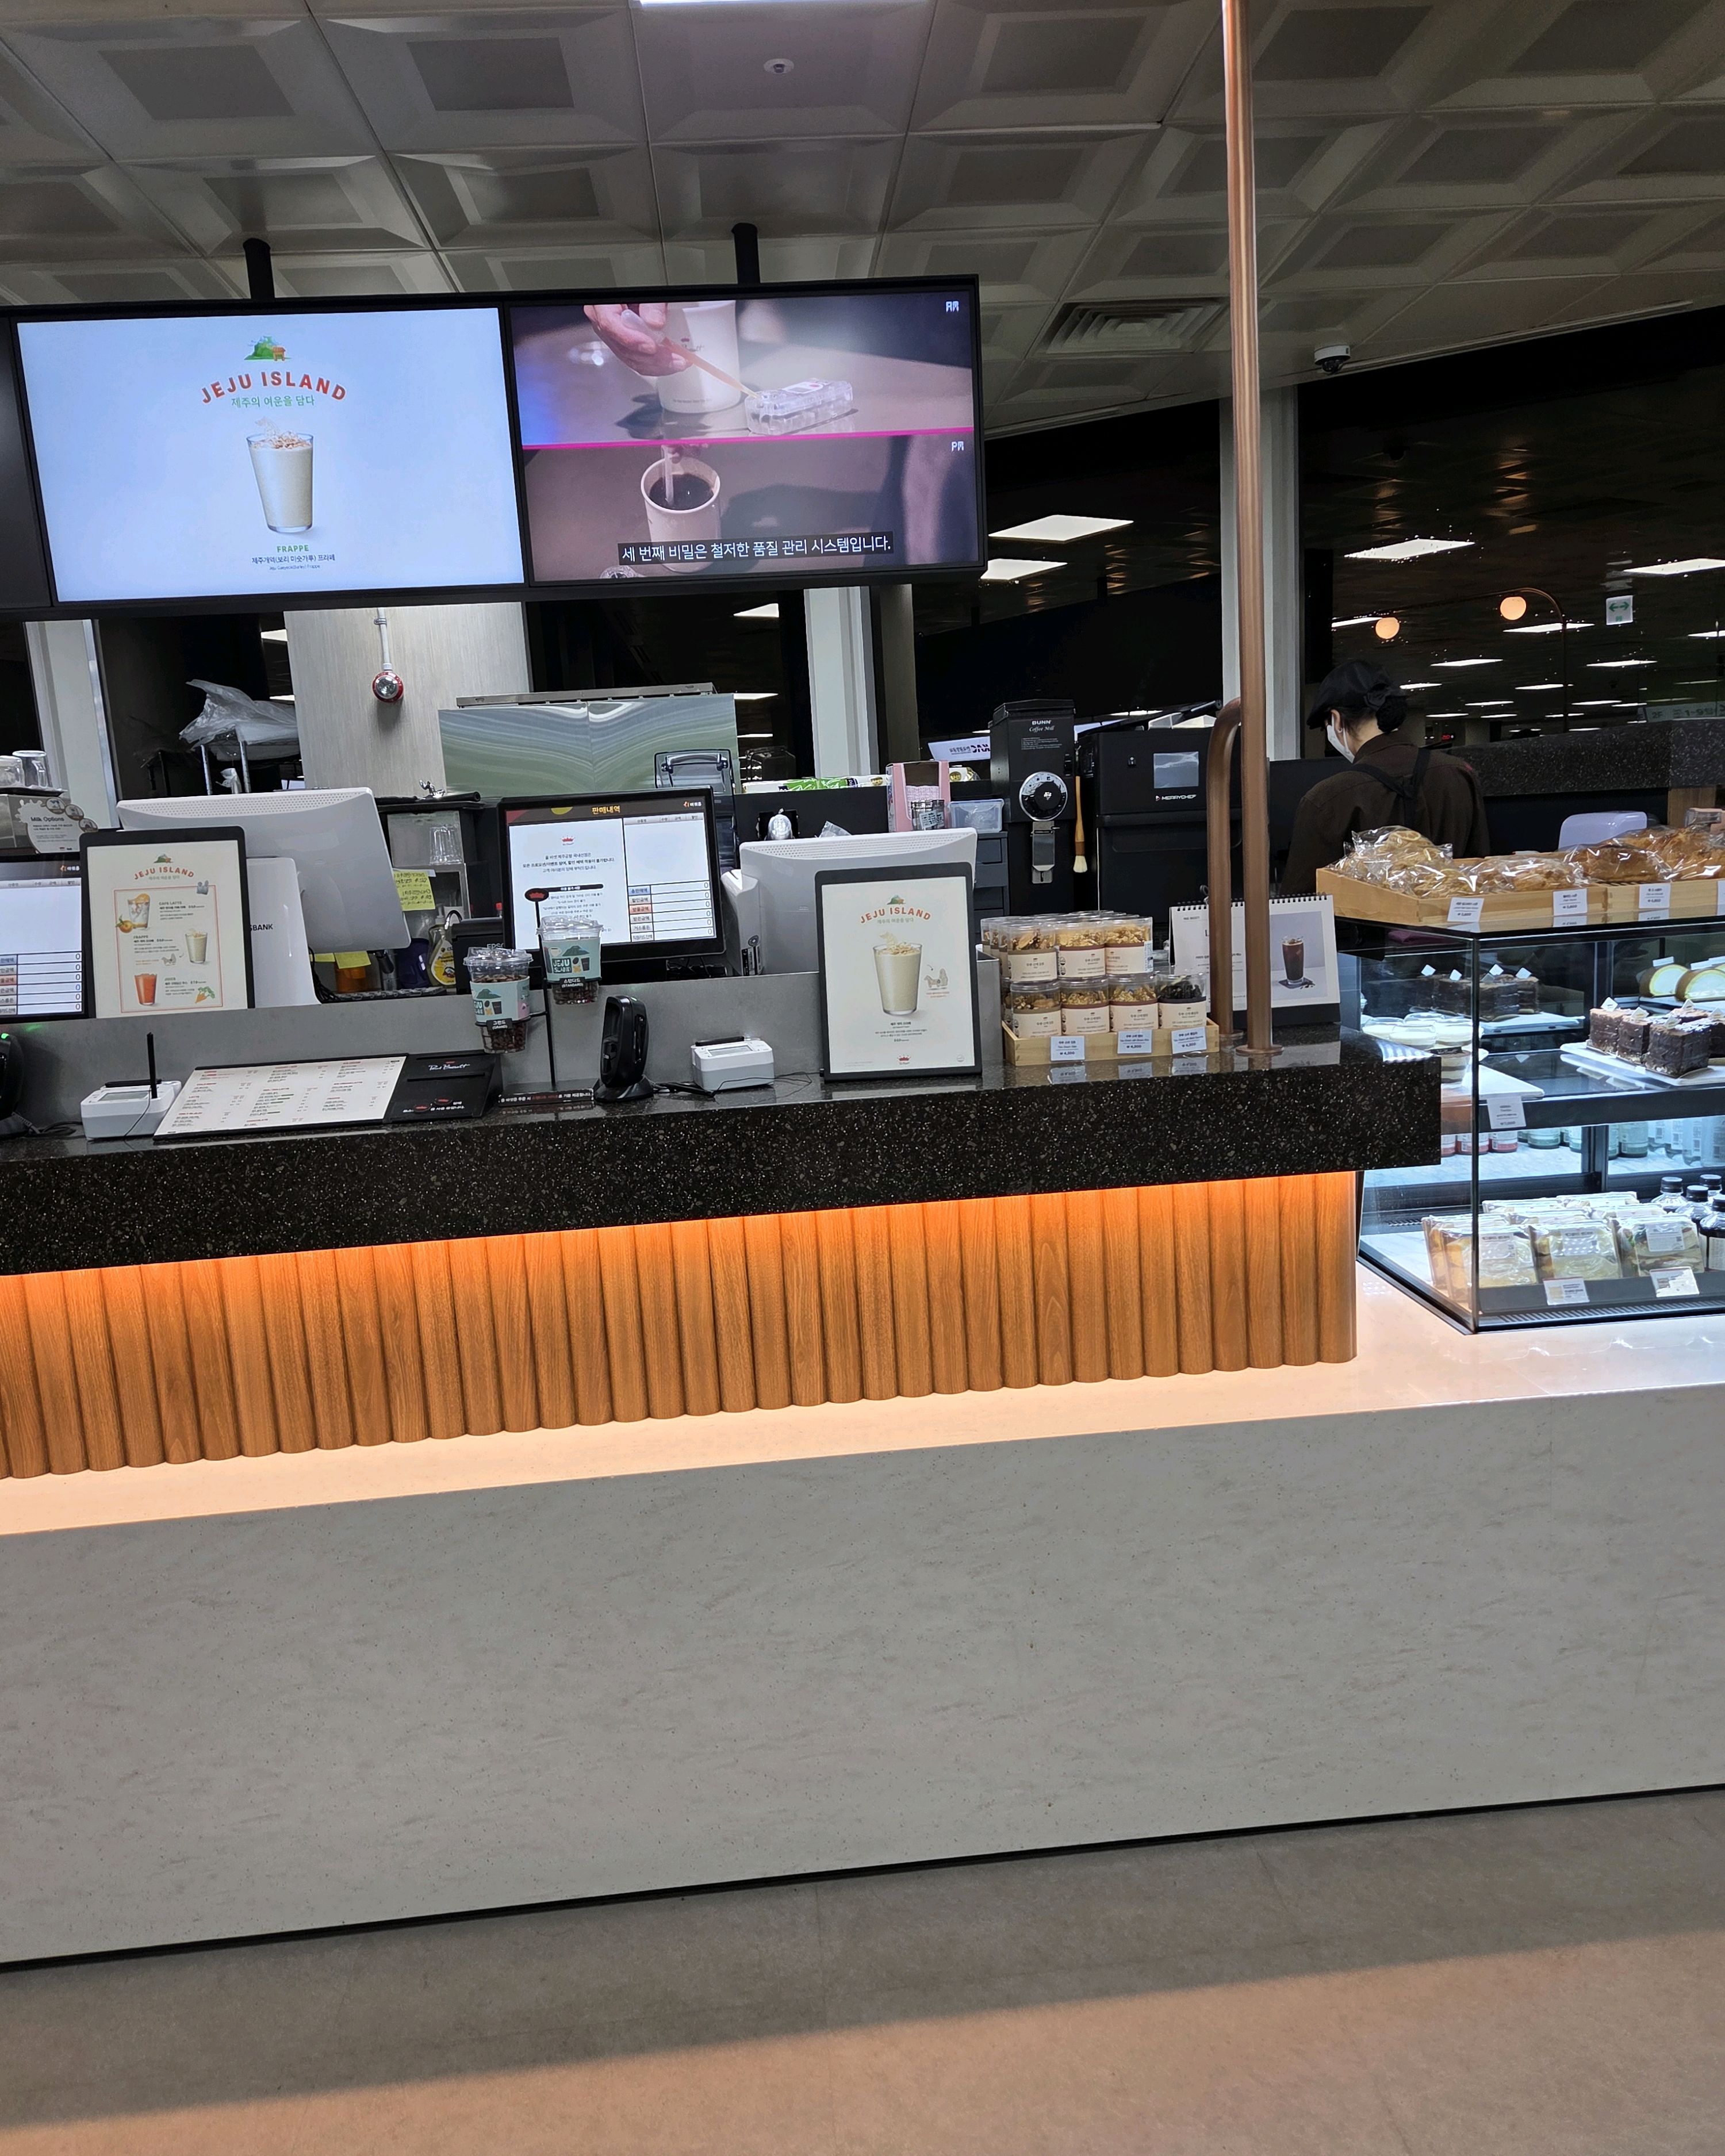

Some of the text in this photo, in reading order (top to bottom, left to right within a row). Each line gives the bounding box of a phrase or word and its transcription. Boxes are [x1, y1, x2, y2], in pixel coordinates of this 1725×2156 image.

[201, 371, 347, 404] JEJU ISLAND
[231, 394, 316, 408] 제주의 여운을 담다
[277, 544, 309, 553] FRAPPE
[622, 535, 891, 562] 세 번째 비밀은 철저한 품질 관리 시스템입니다.
[592, 805, 620, 815] 판매내역
[134, 866, 194, 880] JEJU ISLAND
[860, 907, 930, 923] JEJU ISLAND
